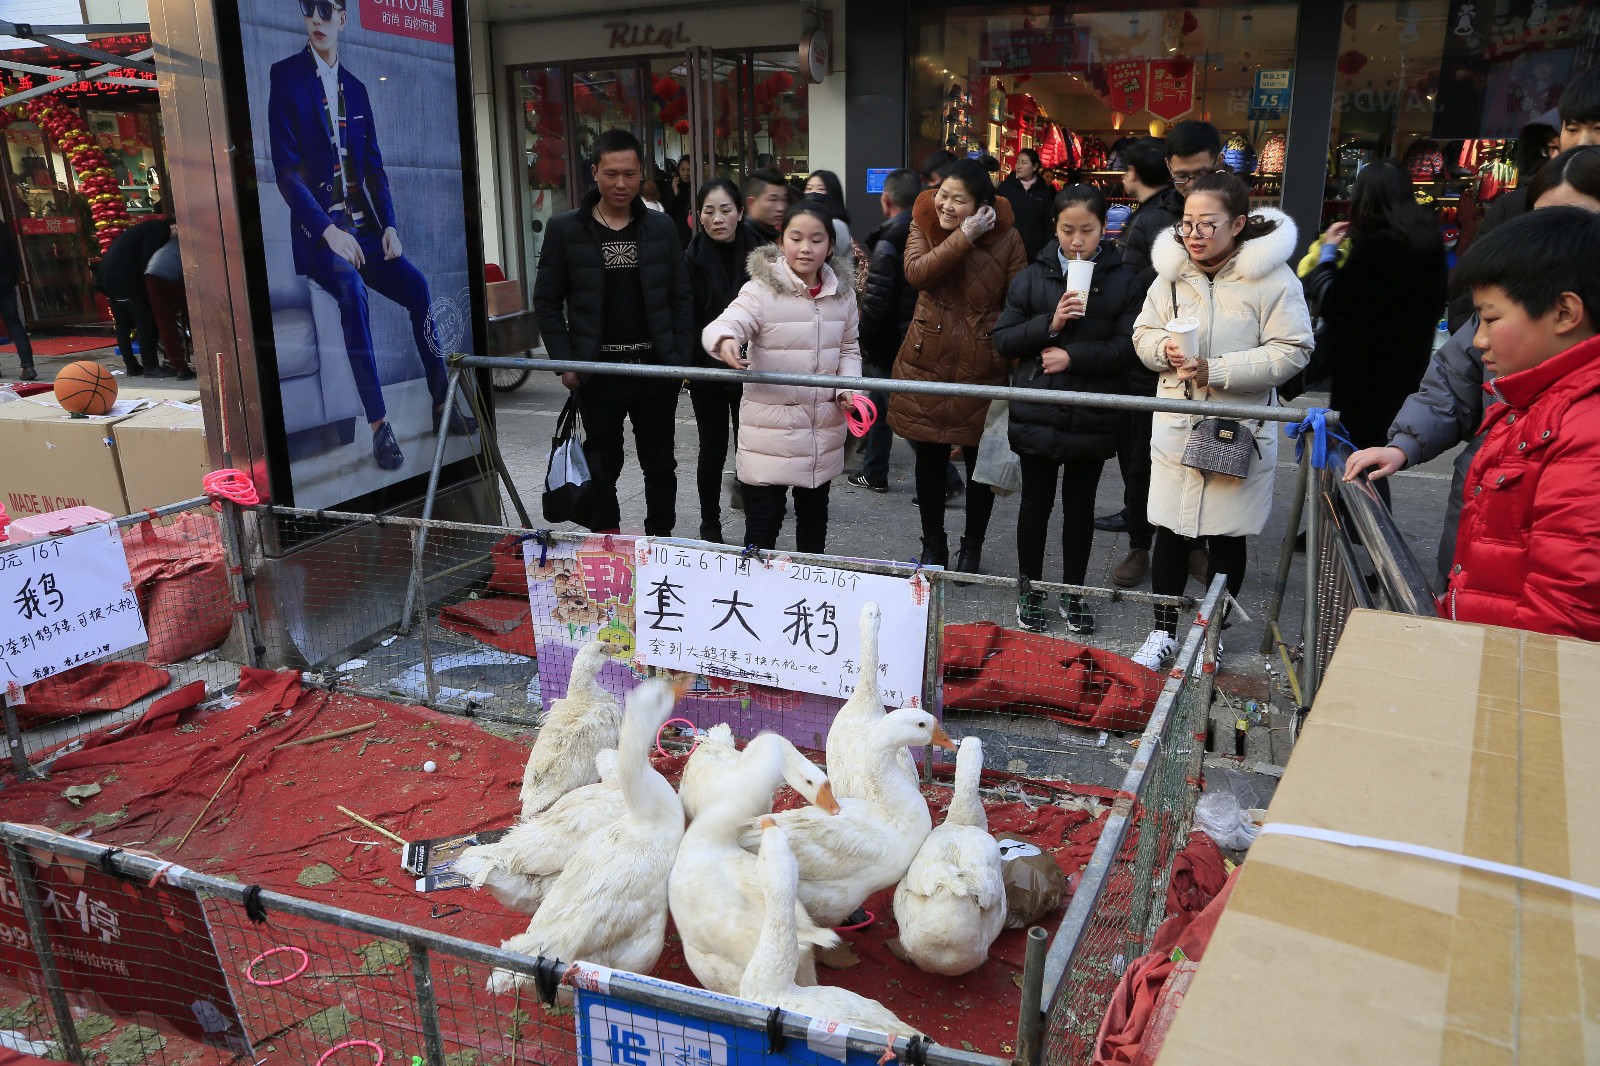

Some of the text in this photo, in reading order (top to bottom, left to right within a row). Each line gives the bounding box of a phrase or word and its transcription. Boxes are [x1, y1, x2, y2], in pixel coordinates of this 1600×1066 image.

[8, 492, 41, 513] MADE
[41, 495, 54, 513] IN
[14, 572, 64, 620] 鹅
[789, 564, 861, 592] 20元16个
[643, 575, 839, 656] 套大鹅
